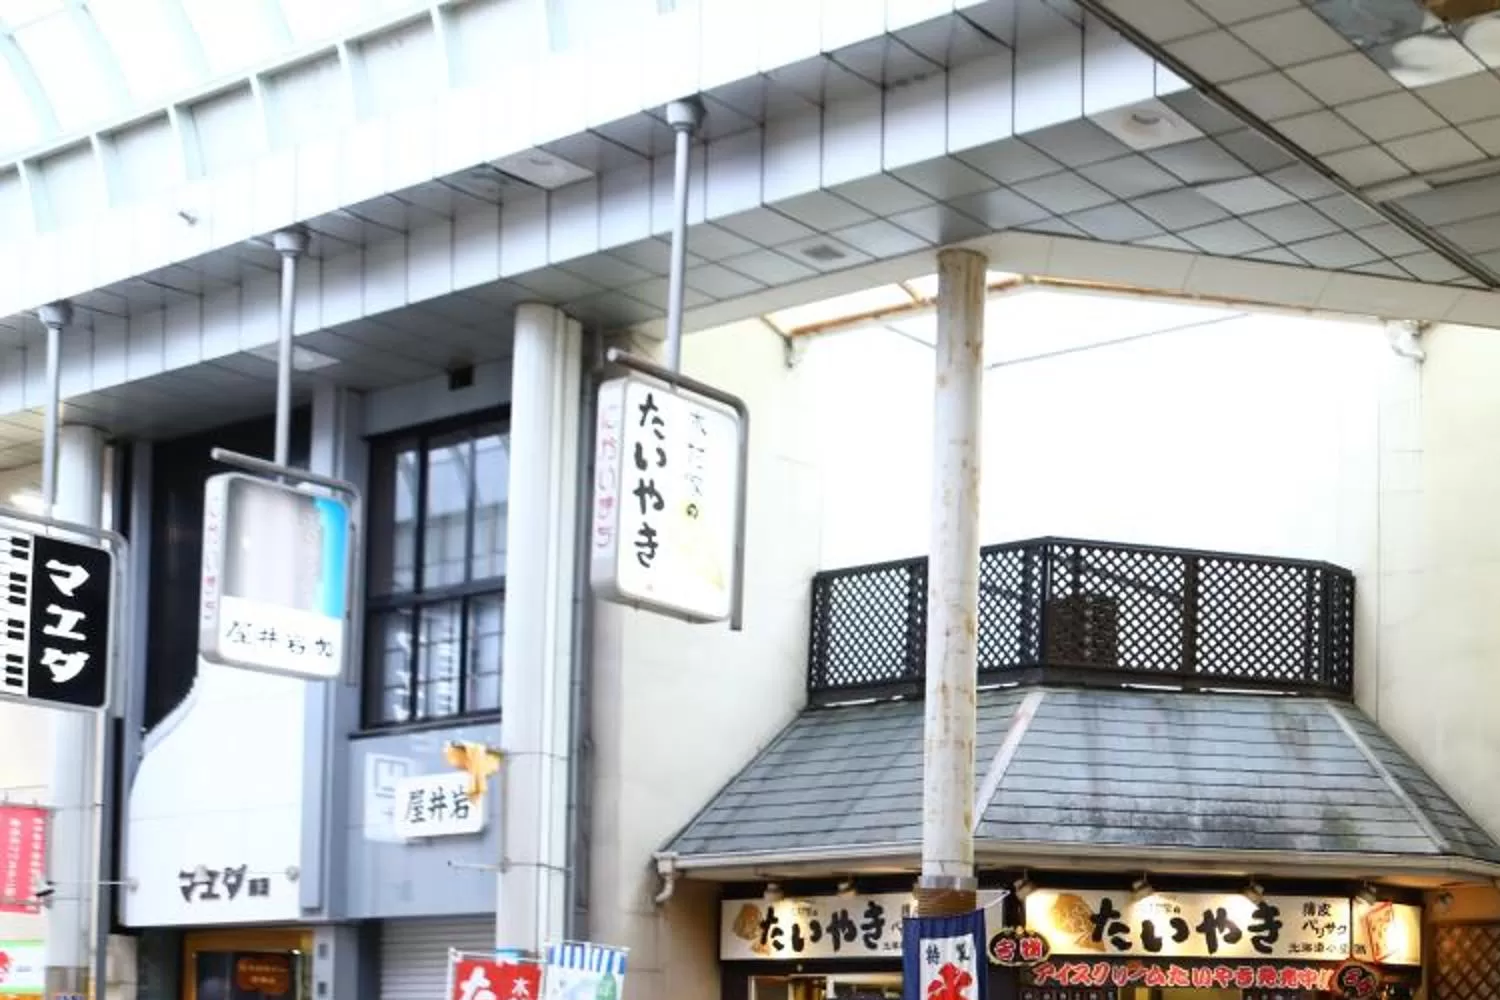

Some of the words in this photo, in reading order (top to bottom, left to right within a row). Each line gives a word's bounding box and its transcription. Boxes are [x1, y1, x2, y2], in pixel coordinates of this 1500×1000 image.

[633, 393, 668, 568] たいやき
[40, 559, 91, 683] マエダ
[760, 900, 886, 953] たいやき
[1090, 897, 1283, 954] たいやき
